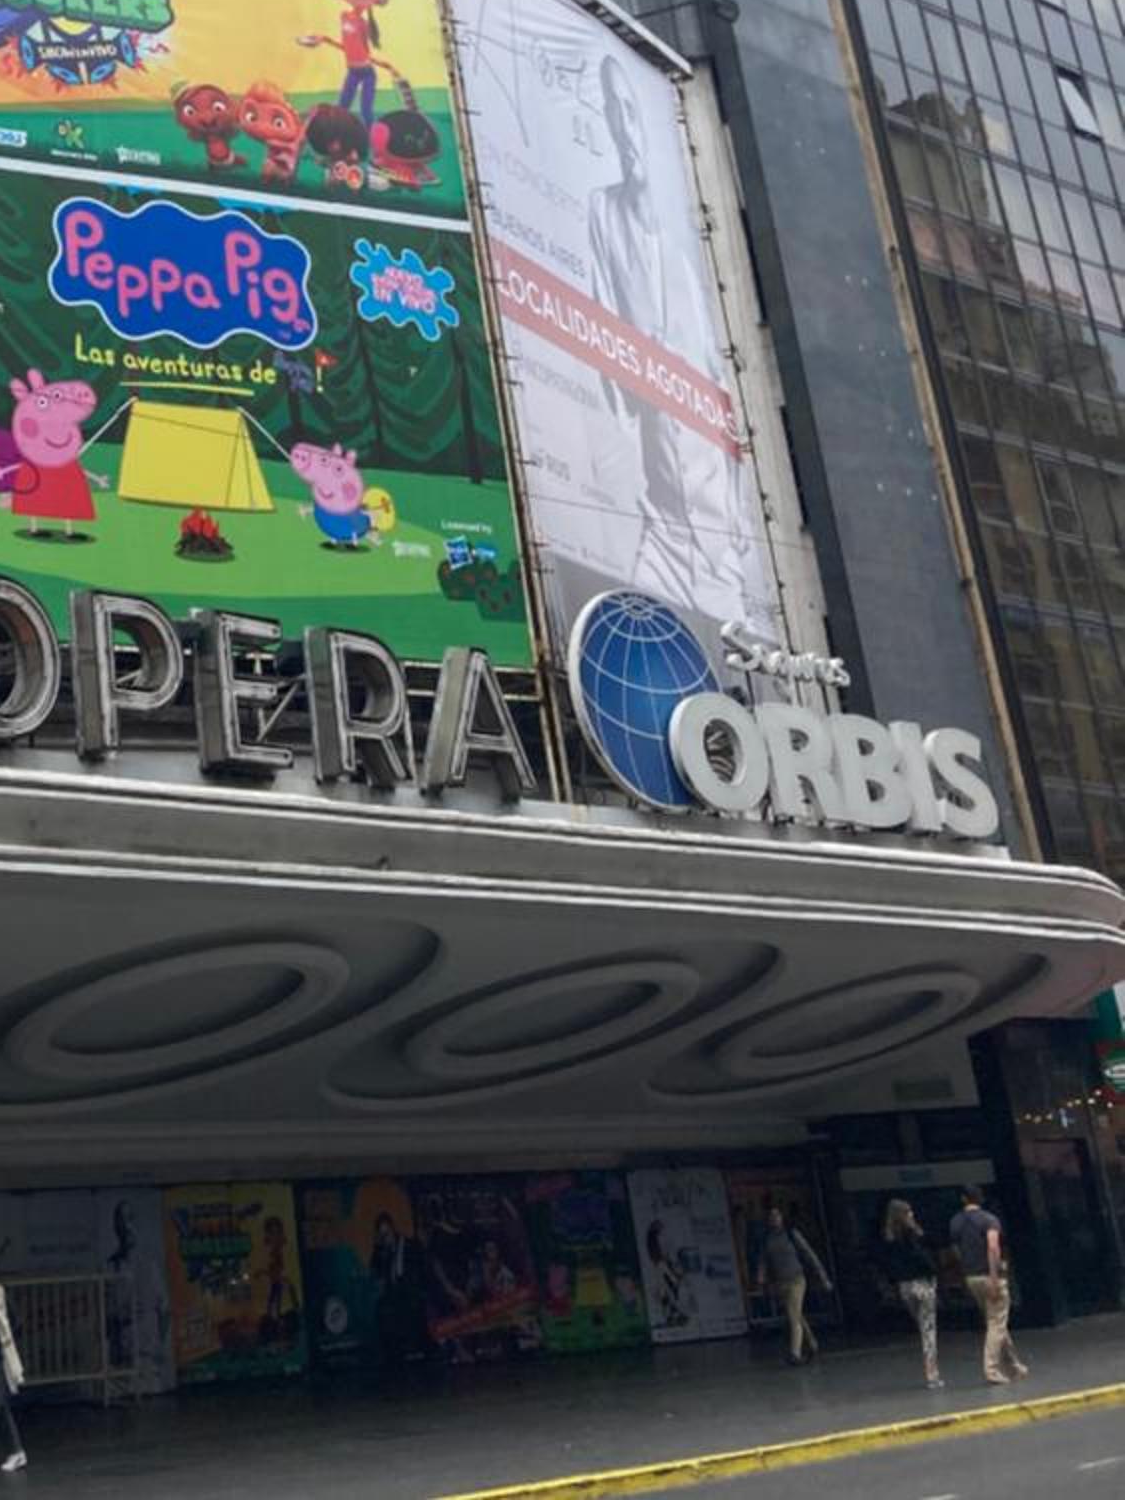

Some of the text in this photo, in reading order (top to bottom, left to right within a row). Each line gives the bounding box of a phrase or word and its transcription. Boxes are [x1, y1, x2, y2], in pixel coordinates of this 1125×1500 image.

[63, 210, 300, 326] Peppa Pig
[74, 331, 115, 367] Las
[122, 351, 243, 382] aventuras
[248, 358, 277, 384] de
[495, 258, 641, 377] LOCALIDADES
[645, 355, 741, 442] AGOTADAS
[668, 691, 999, 838] ORBIS
